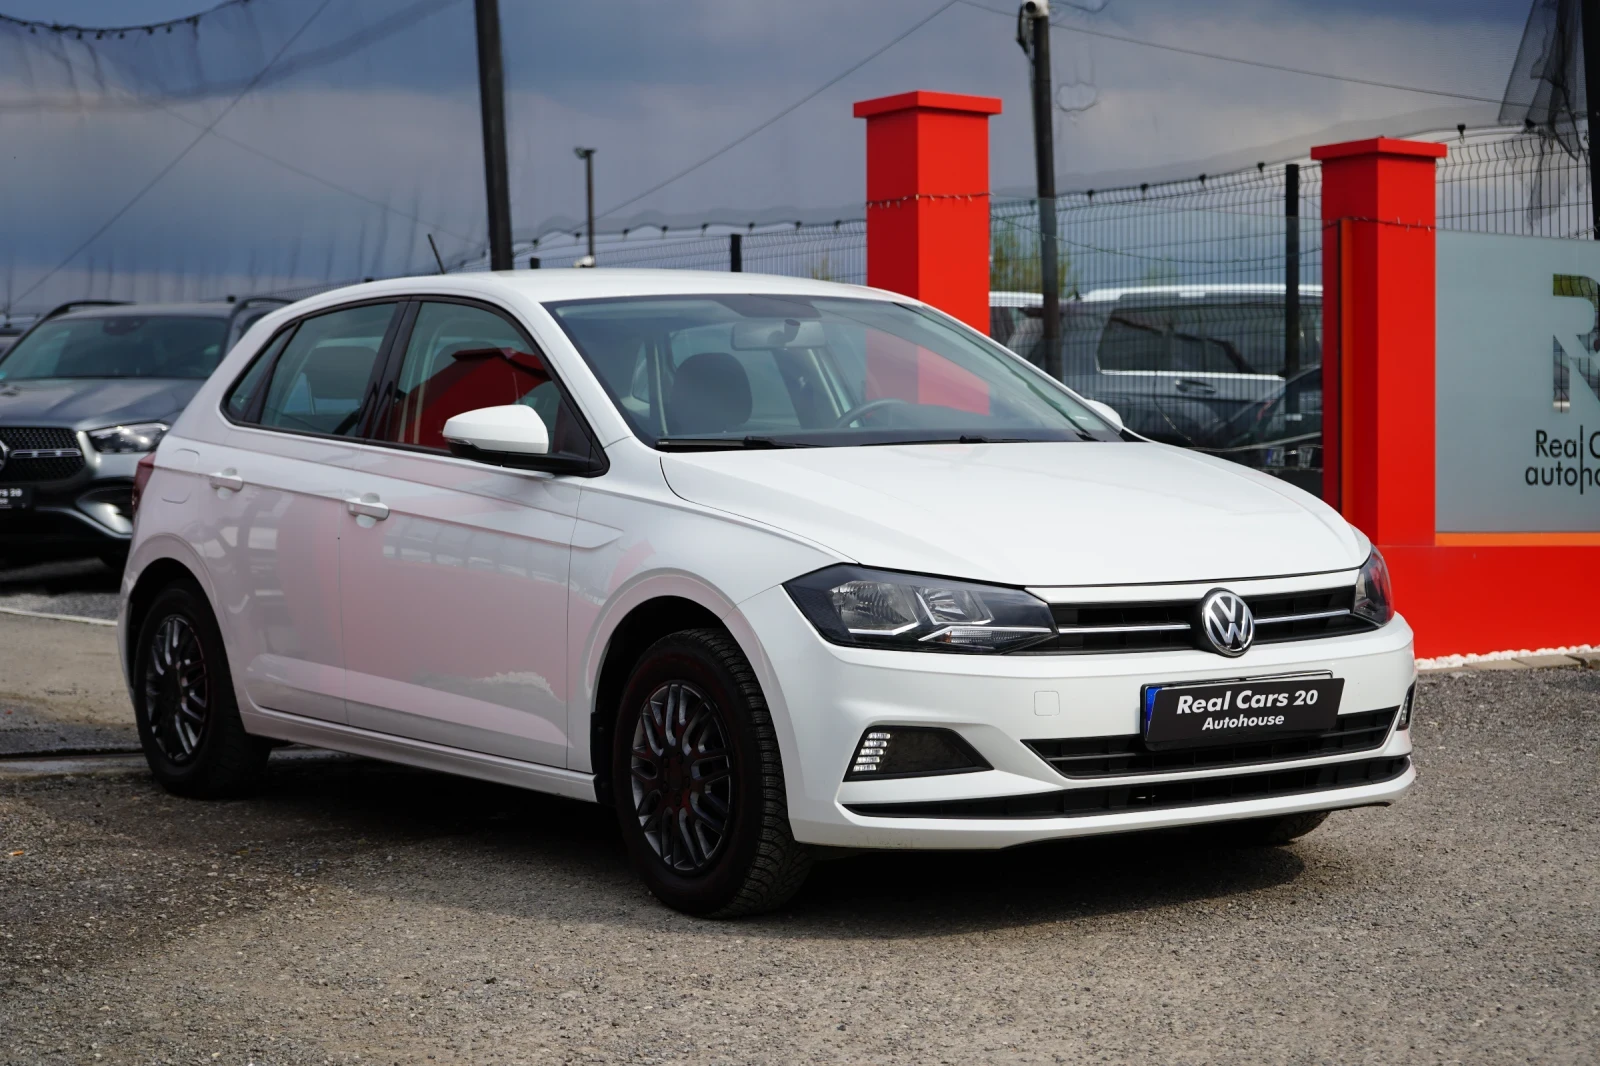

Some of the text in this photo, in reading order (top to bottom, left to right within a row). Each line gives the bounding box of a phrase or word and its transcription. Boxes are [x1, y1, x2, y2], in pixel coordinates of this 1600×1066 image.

[1176, 689, 1318, 715] Real Cars 20
[1202, 714, 1285, 731] Autohouse
